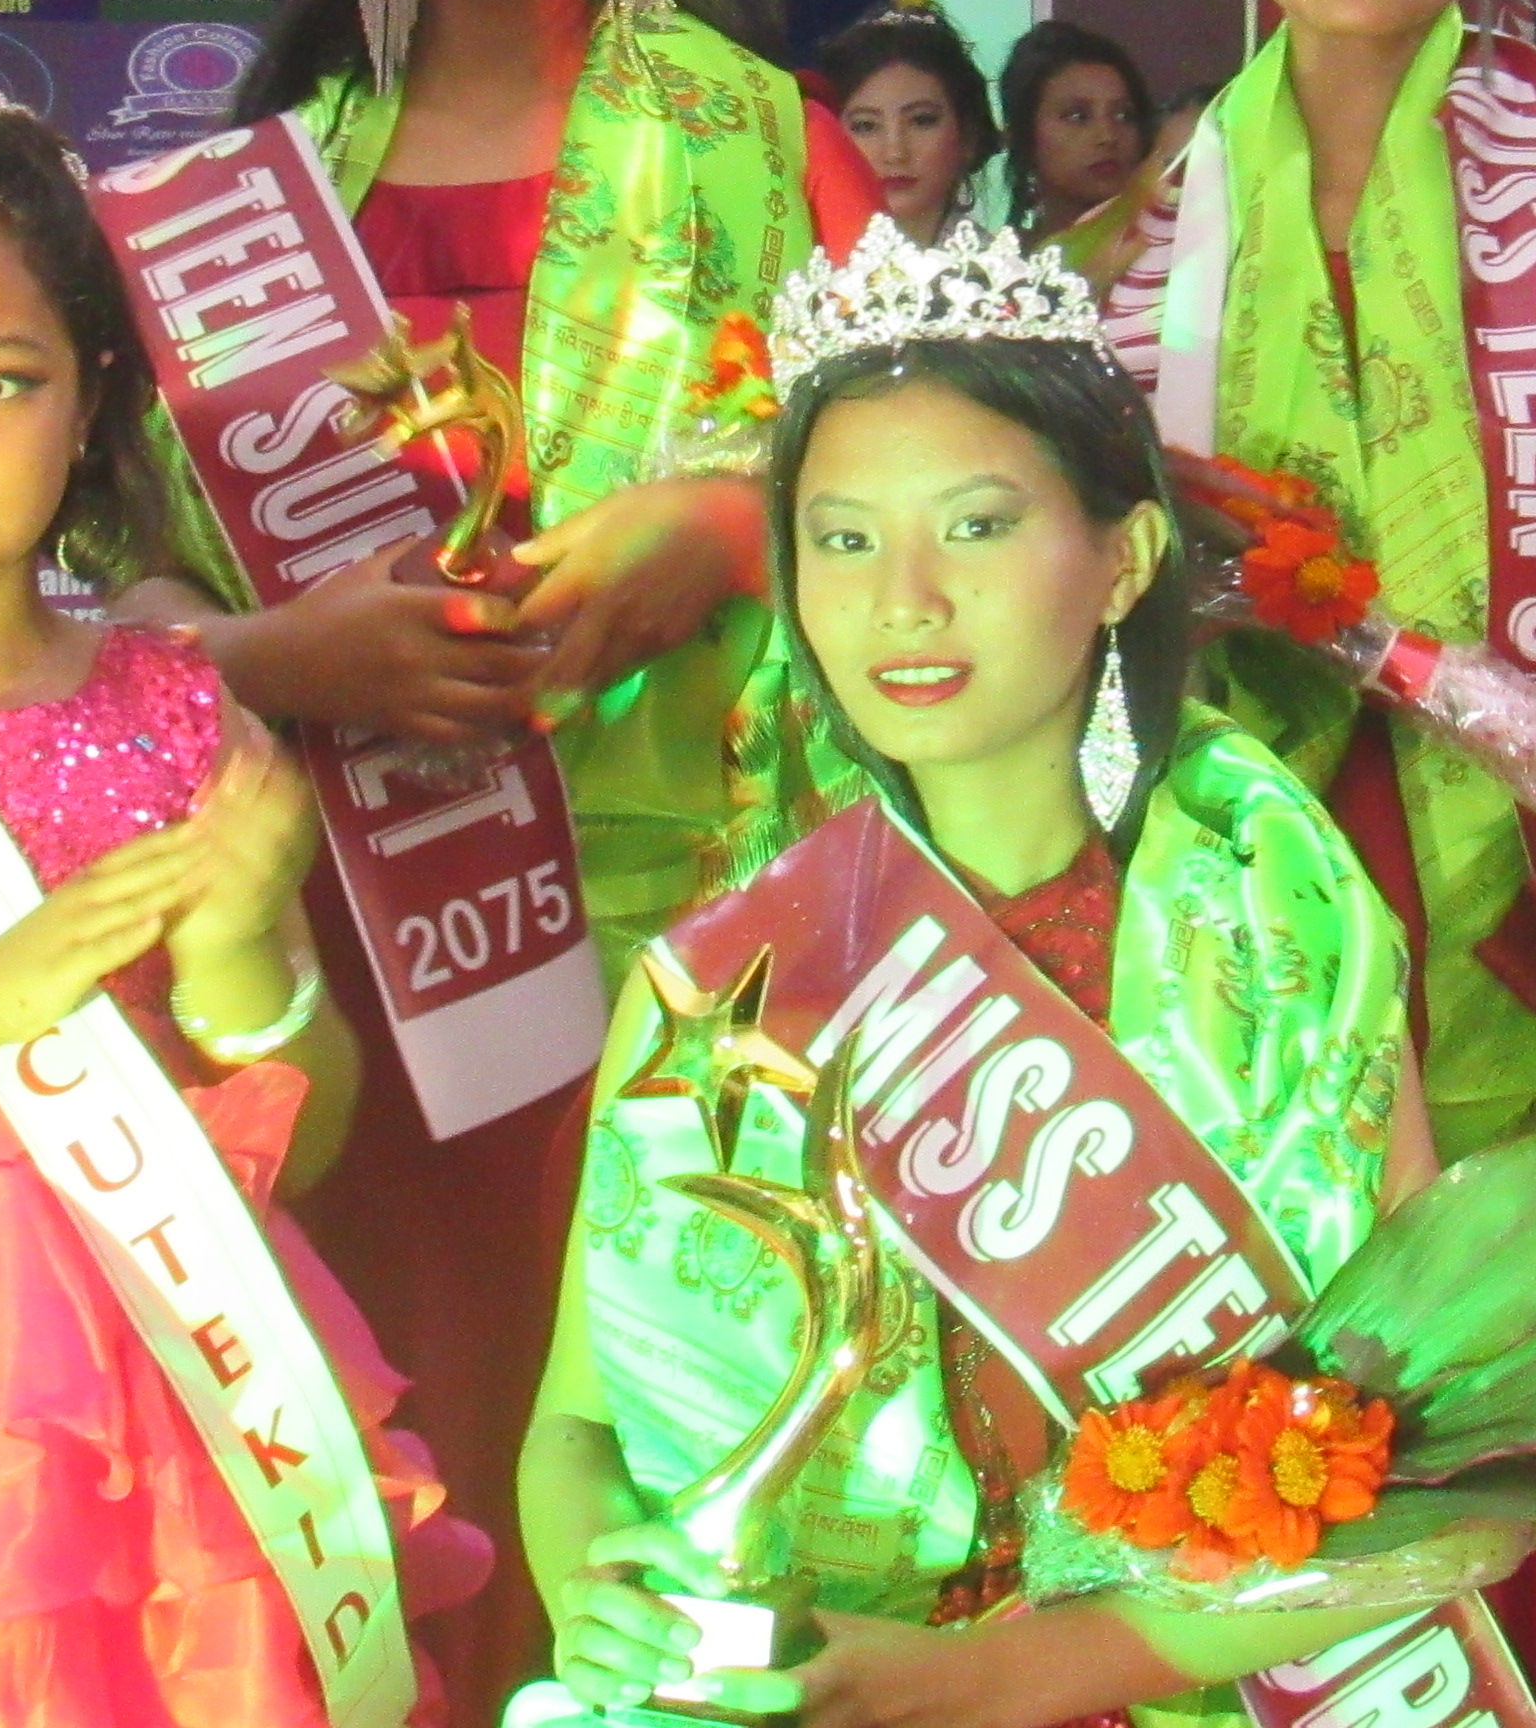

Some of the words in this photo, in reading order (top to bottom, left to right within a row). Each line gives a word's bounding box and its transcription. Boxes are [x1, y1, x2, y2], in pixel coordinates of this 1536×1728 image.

[126, 166, 350, 391] TEEN
[396, 859, 572, 993] 2075
[807, 914, 1134, 1261] MISS
